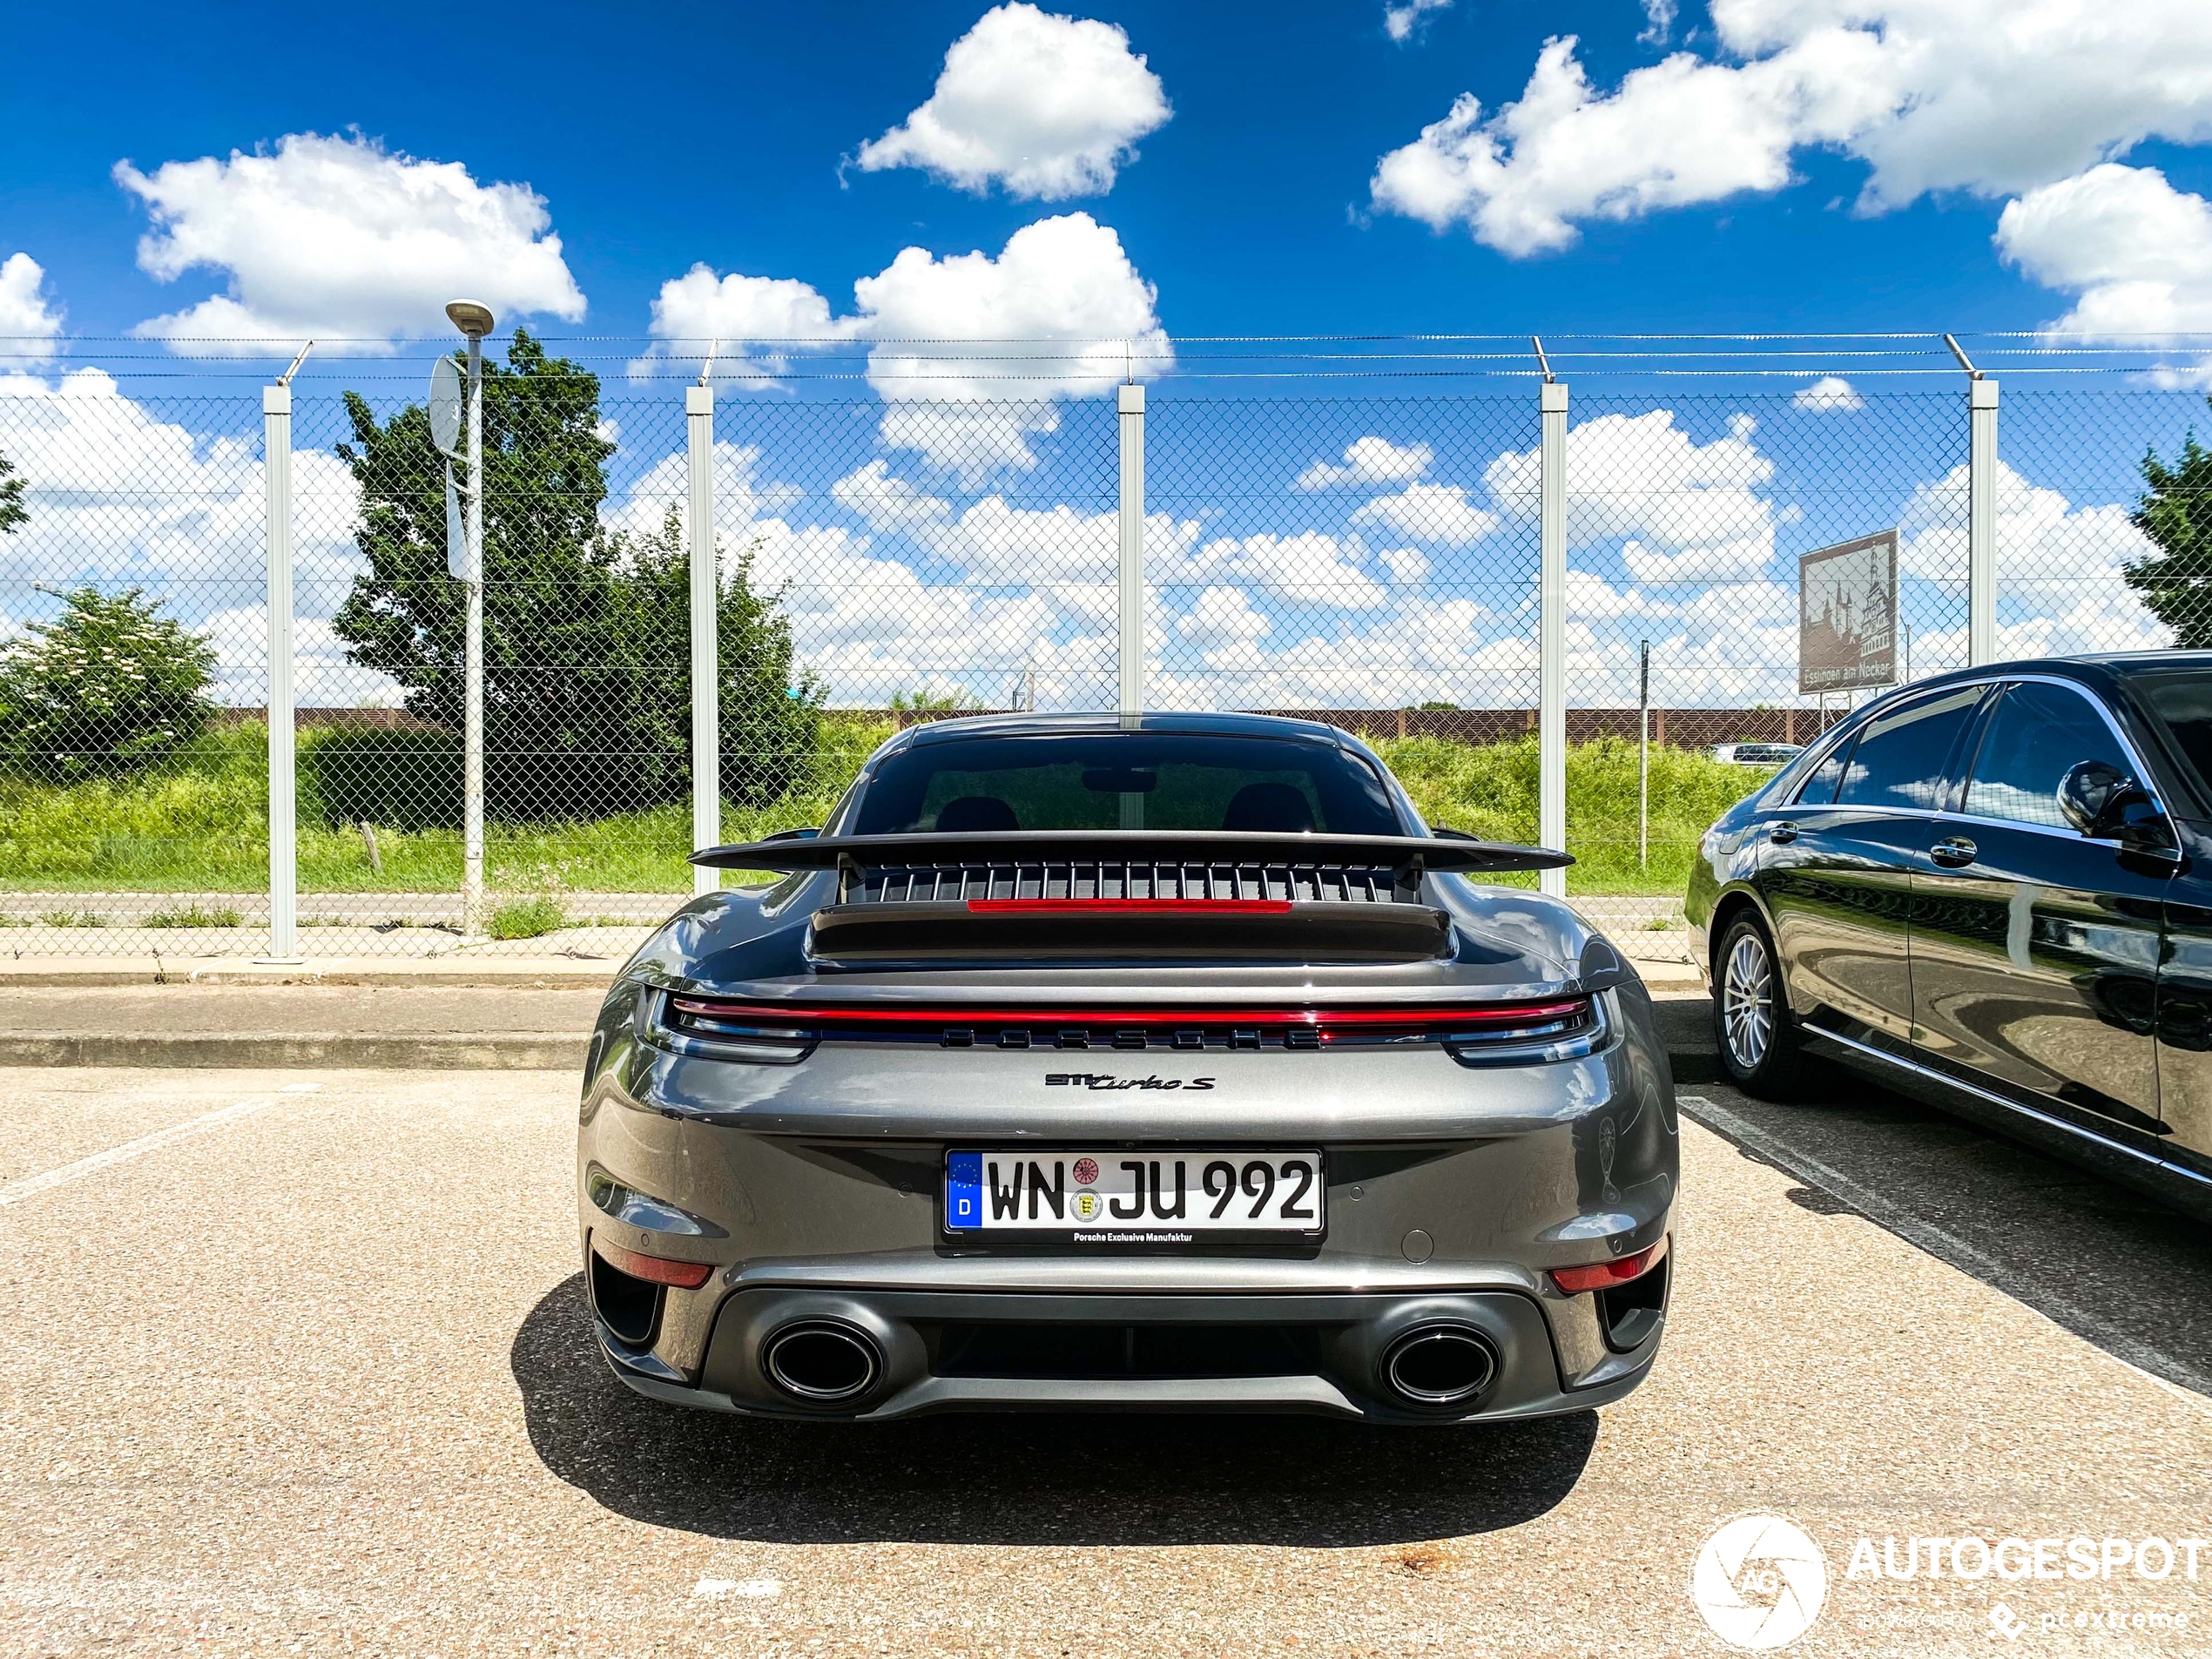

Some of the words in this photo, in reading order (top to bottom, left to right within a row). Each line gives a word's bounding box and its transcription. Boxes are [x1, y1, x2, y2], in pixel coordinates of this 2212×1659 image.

[1804, 666, 1841, 685] Esslingen
[1844, 669, 1857, 680] am
[1858, 660, 1890, 678] Neckar
[941, 1028, 1320, 1049] PORSCHE
[1183, 1078, 1216, 1089] S
[988, 1160, 1065, 1220] WN
[1109, 1160, 1186, 1220] JU
[1201, 1160, 1314, 1219] 992
[958, 1198, 971, 1216] D
[1074, 1232, 1106, 1242] Porsche
[1107, 1232, 1144, 1242] Exclusive
[1145, 1232, 1192, 1242] Manufaktur
